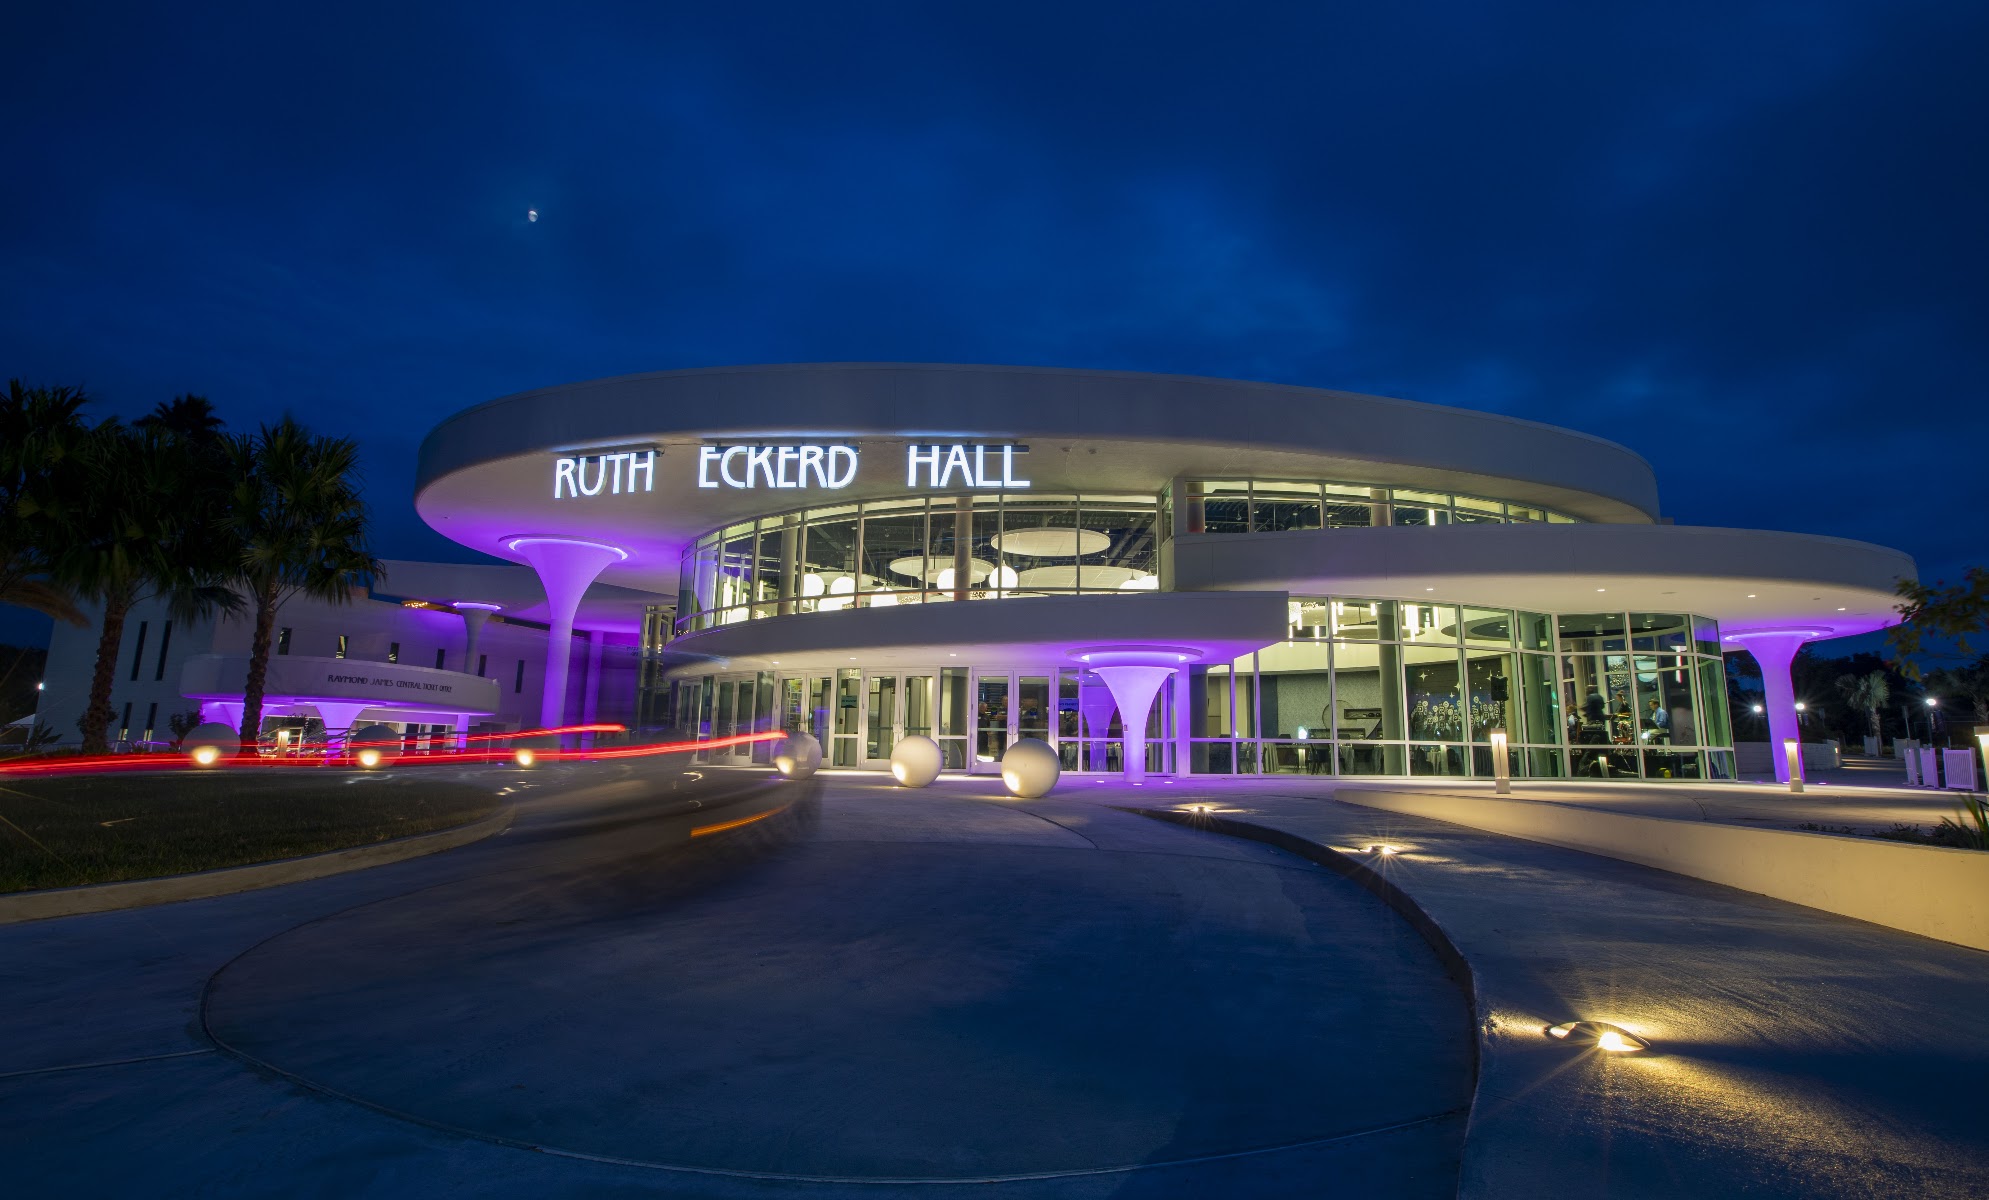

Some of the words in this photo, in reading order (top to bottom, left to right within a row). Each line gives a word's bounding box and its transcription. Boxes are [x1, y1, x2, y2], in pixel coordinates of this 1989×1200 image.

[554, 451, 655, 499] RUTH
[697, 446, 858, 489] ECKERD
[907, 445, 1031, 488] HALL
[328, 674, 368, 685] RAYMOND
[370, 679, 394, 687] JAMES
[396, 680, 422, 690] CENTRAL
